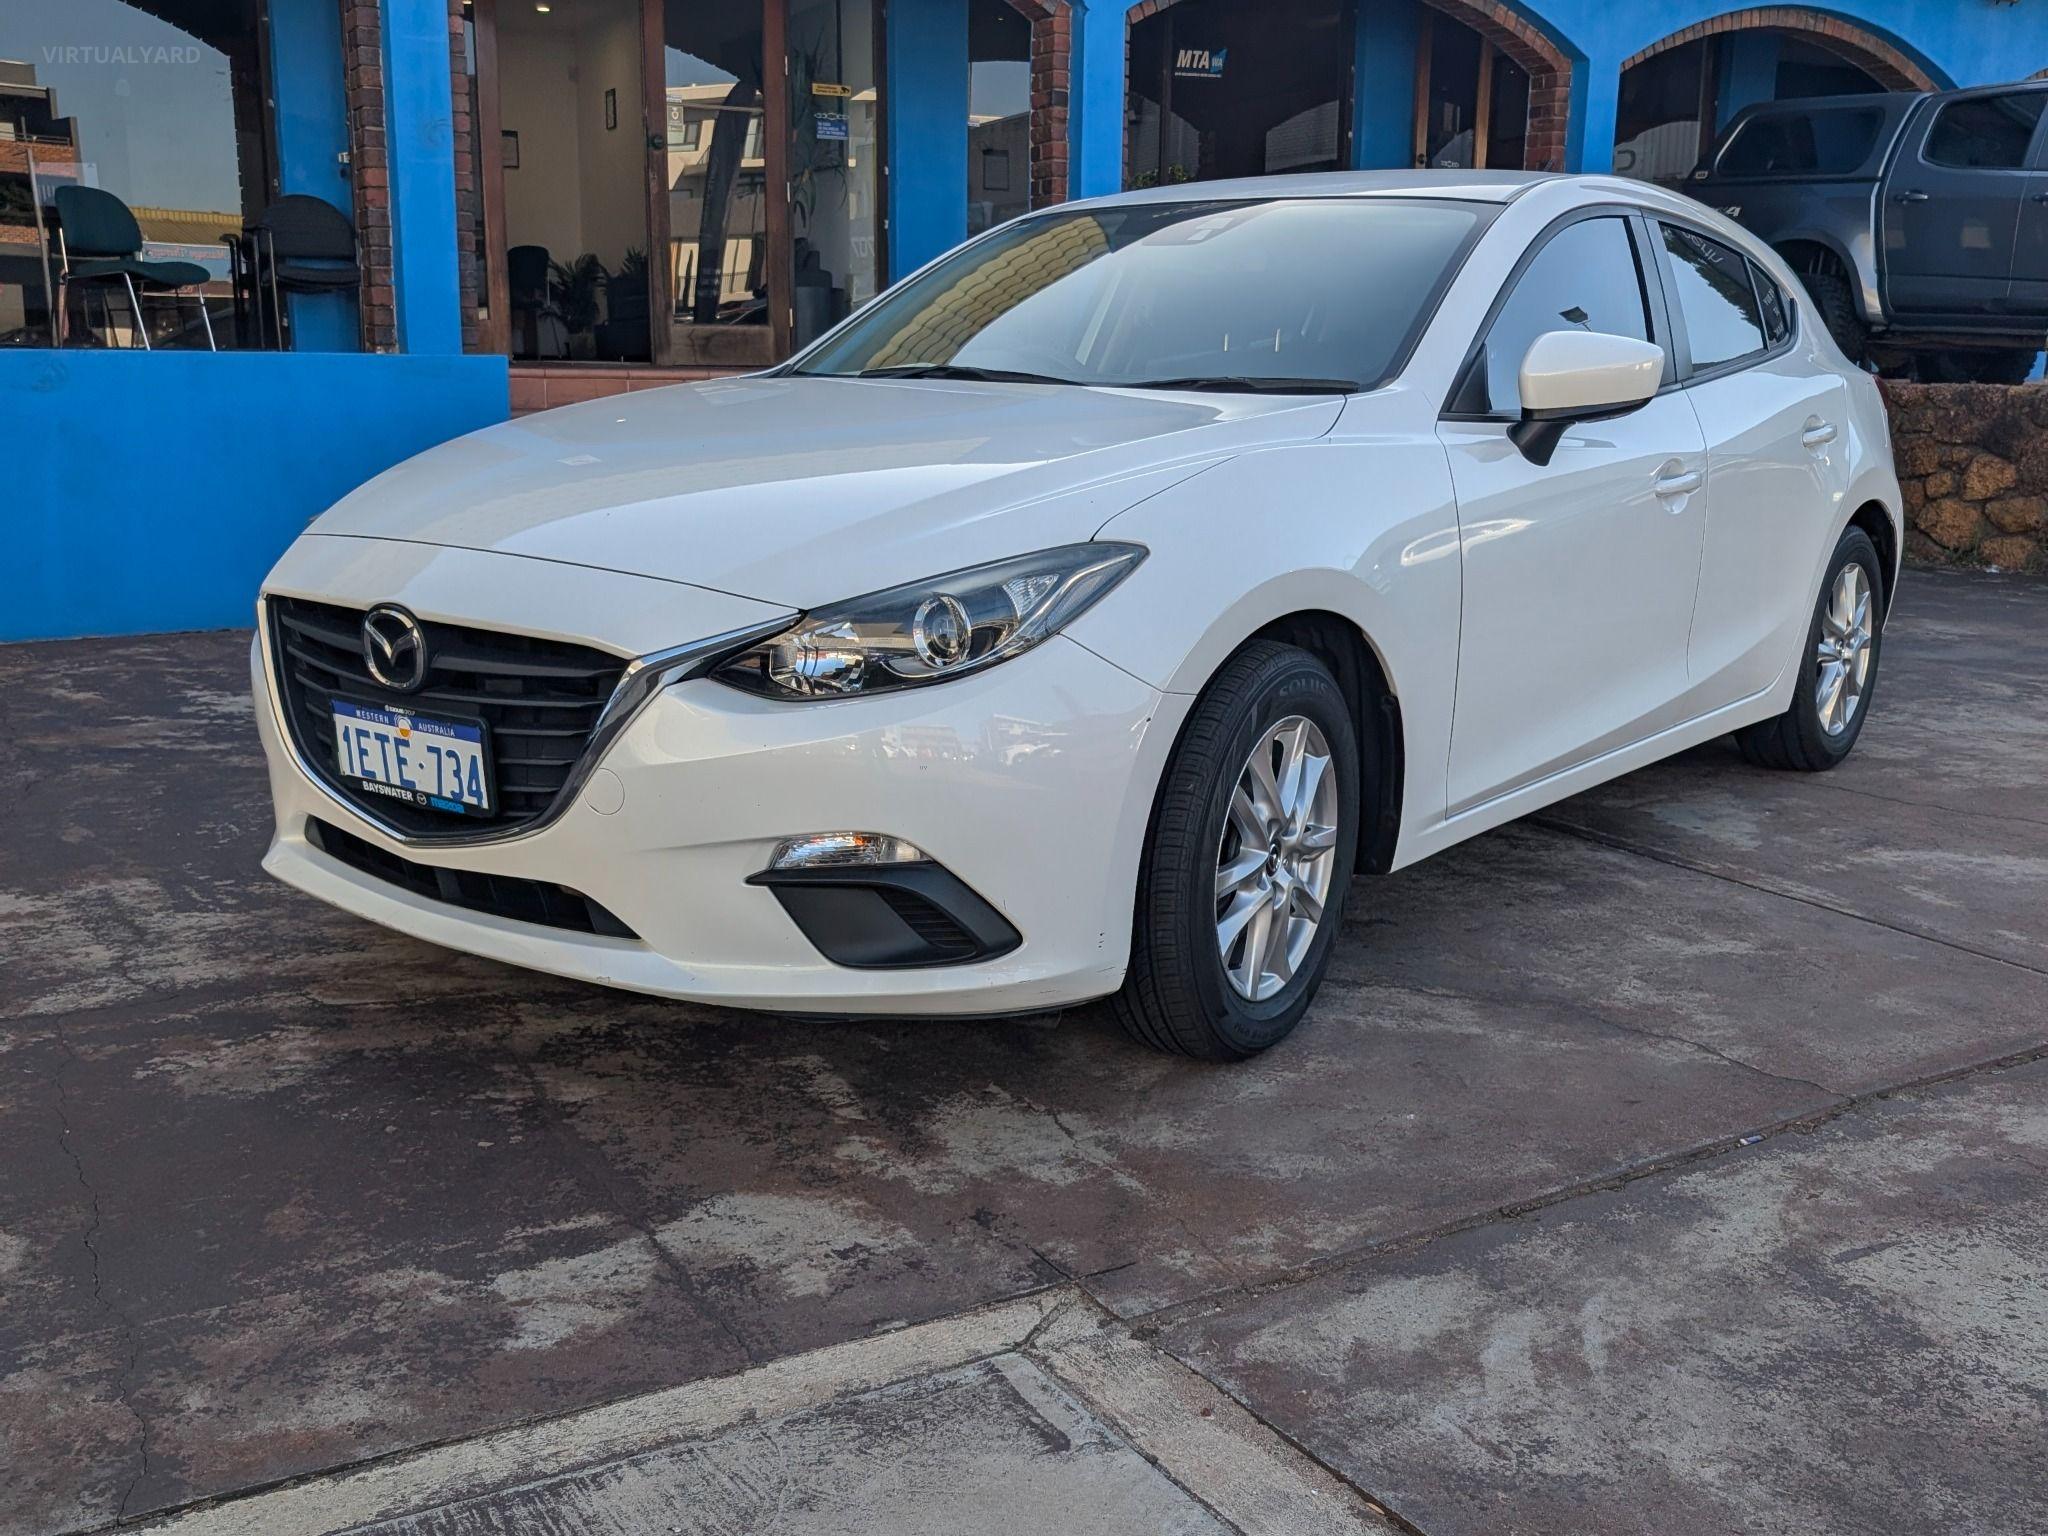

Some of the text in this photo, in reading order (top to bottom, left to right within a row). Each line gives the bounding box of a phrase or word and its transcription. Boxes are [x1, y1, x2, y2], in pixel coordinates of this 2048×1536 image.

[1176, 49, 1210, 69] MTA
[356, 709, 389, 724] WESTERN
[418, 722, 455, 737] AUSTRALIA
[362, 781, 414, 801] BAYSWATER
